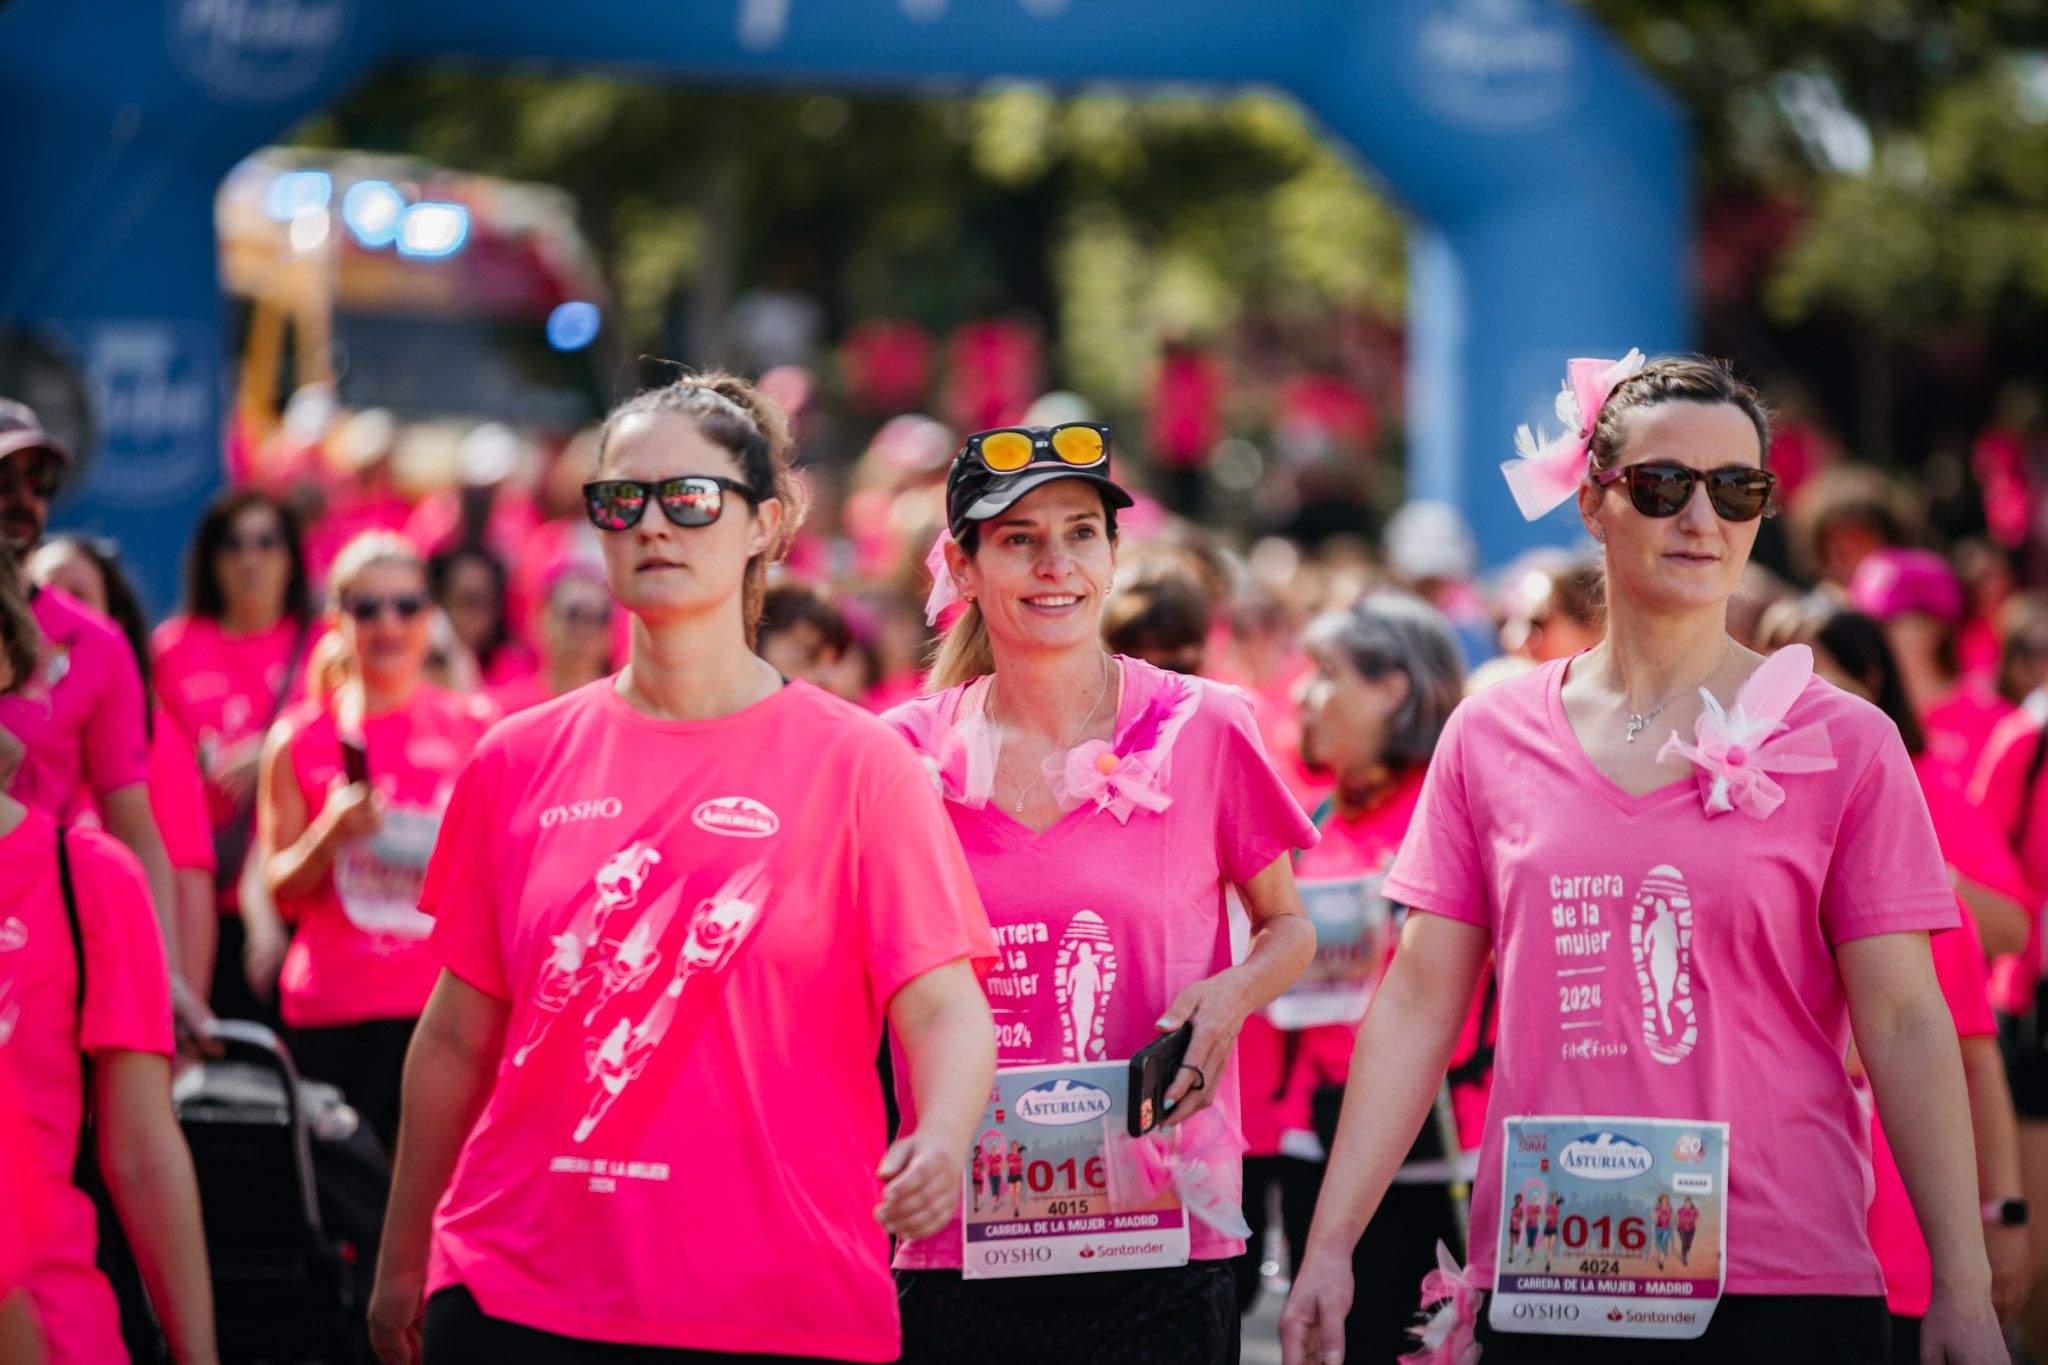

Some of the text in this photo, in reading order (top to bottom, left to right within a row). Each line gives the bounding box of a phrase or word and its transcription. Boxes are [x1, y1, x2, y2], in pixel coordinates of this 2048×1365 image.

[540, 797, 622, 829] OYSHO
[1550, 873, 1623, 899] Carrera
[1552, 900, 1600, 928] de la
[1555, 928, 1611, 956] mujer
[1007, 949, 1028, 970] la
[986, 972, 1039, 998] mujer
[1559, 984, 1602, 1013] 2024
[1022, 1098, 1106, 1117] ASTURIANA
[1565, 1149, 1647, 1169] ASTURIANA
[1028, 1156, 1106, 1192] 016
[1048, 1199, 1088, 1215] 4015
[985, 1214, 1158, 1237] CARRERA DE LA MUJER MADRID
[1562, 1214, 1647, 1250] 016
[985, 1246, 1052, 1266] OYSHO
[1097, 1242, 1165, 1258] Santander
[1579, 1259, 1621, 1275] 4024
[1517, 1277, 1693, 1295] CARRERA DE LA MUJER MADRID
[1513, 1302, 1580, 1321] OYSHO
[1625, 1308, 1697, 1325] Santander
